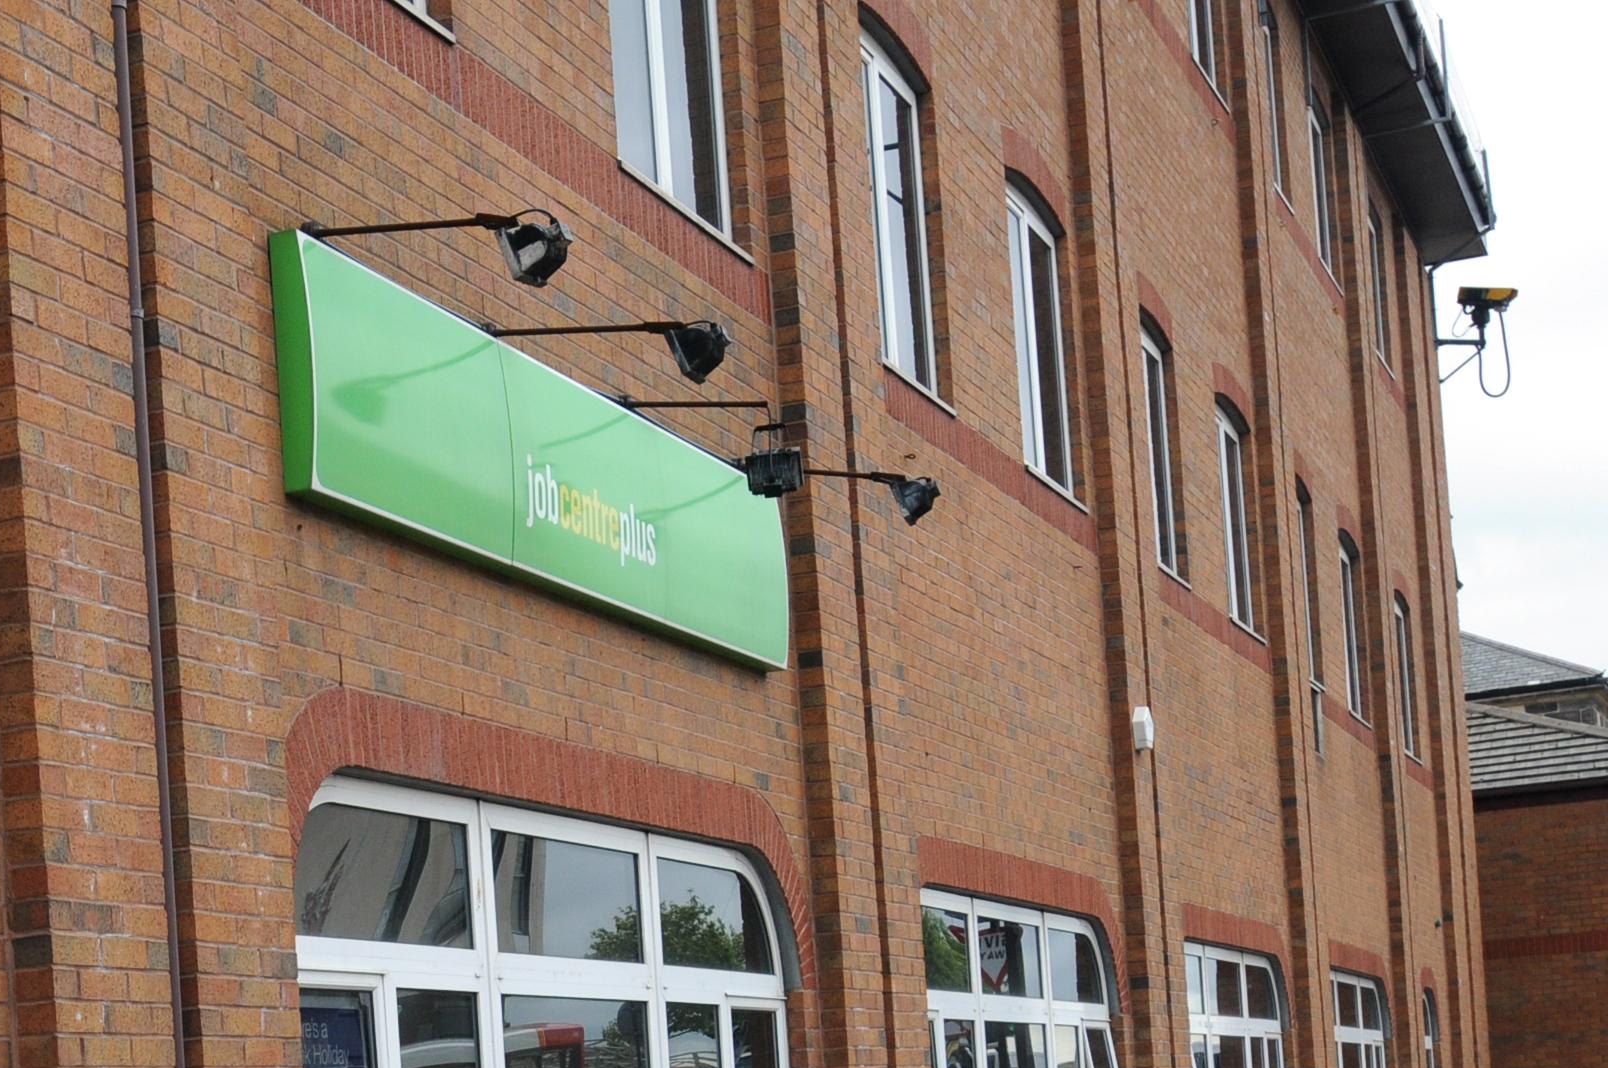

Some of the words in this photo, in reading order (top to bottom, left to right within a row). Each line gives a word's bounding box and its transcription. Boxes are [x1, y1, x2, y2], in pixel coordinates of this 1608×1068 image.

[526, 453, 656, 567] jobcentreplus
[321, 1022, 328, 1038] a
[313, 1044, 349, 1067] Holiday
